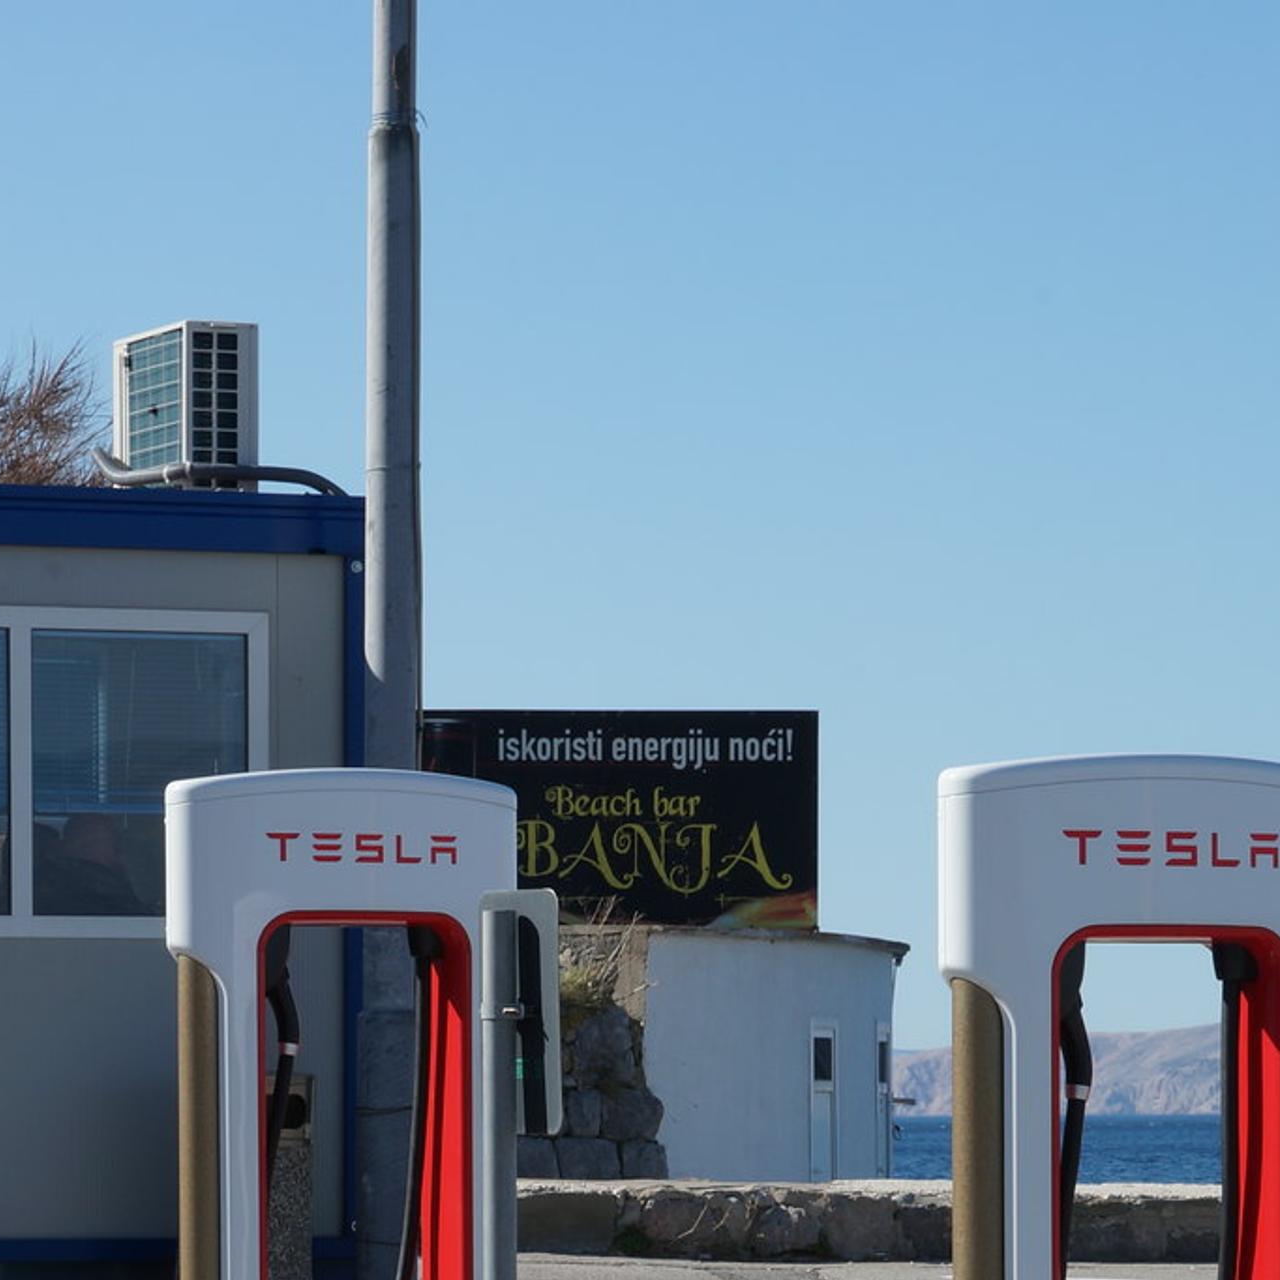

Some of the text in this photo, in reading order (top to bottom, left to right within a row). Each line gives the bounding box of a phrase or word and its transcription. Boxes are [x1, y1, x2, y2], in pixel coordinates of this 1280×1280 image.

[498, 728, 794, 770] iskoristi energiju noći!
[545, 784, 701, 818] Beach bar
[265, 832, 457, 865] TESLA
[517, 815, 793, 895] BANJA
[1062, 830, 1279, 868] TESLA
